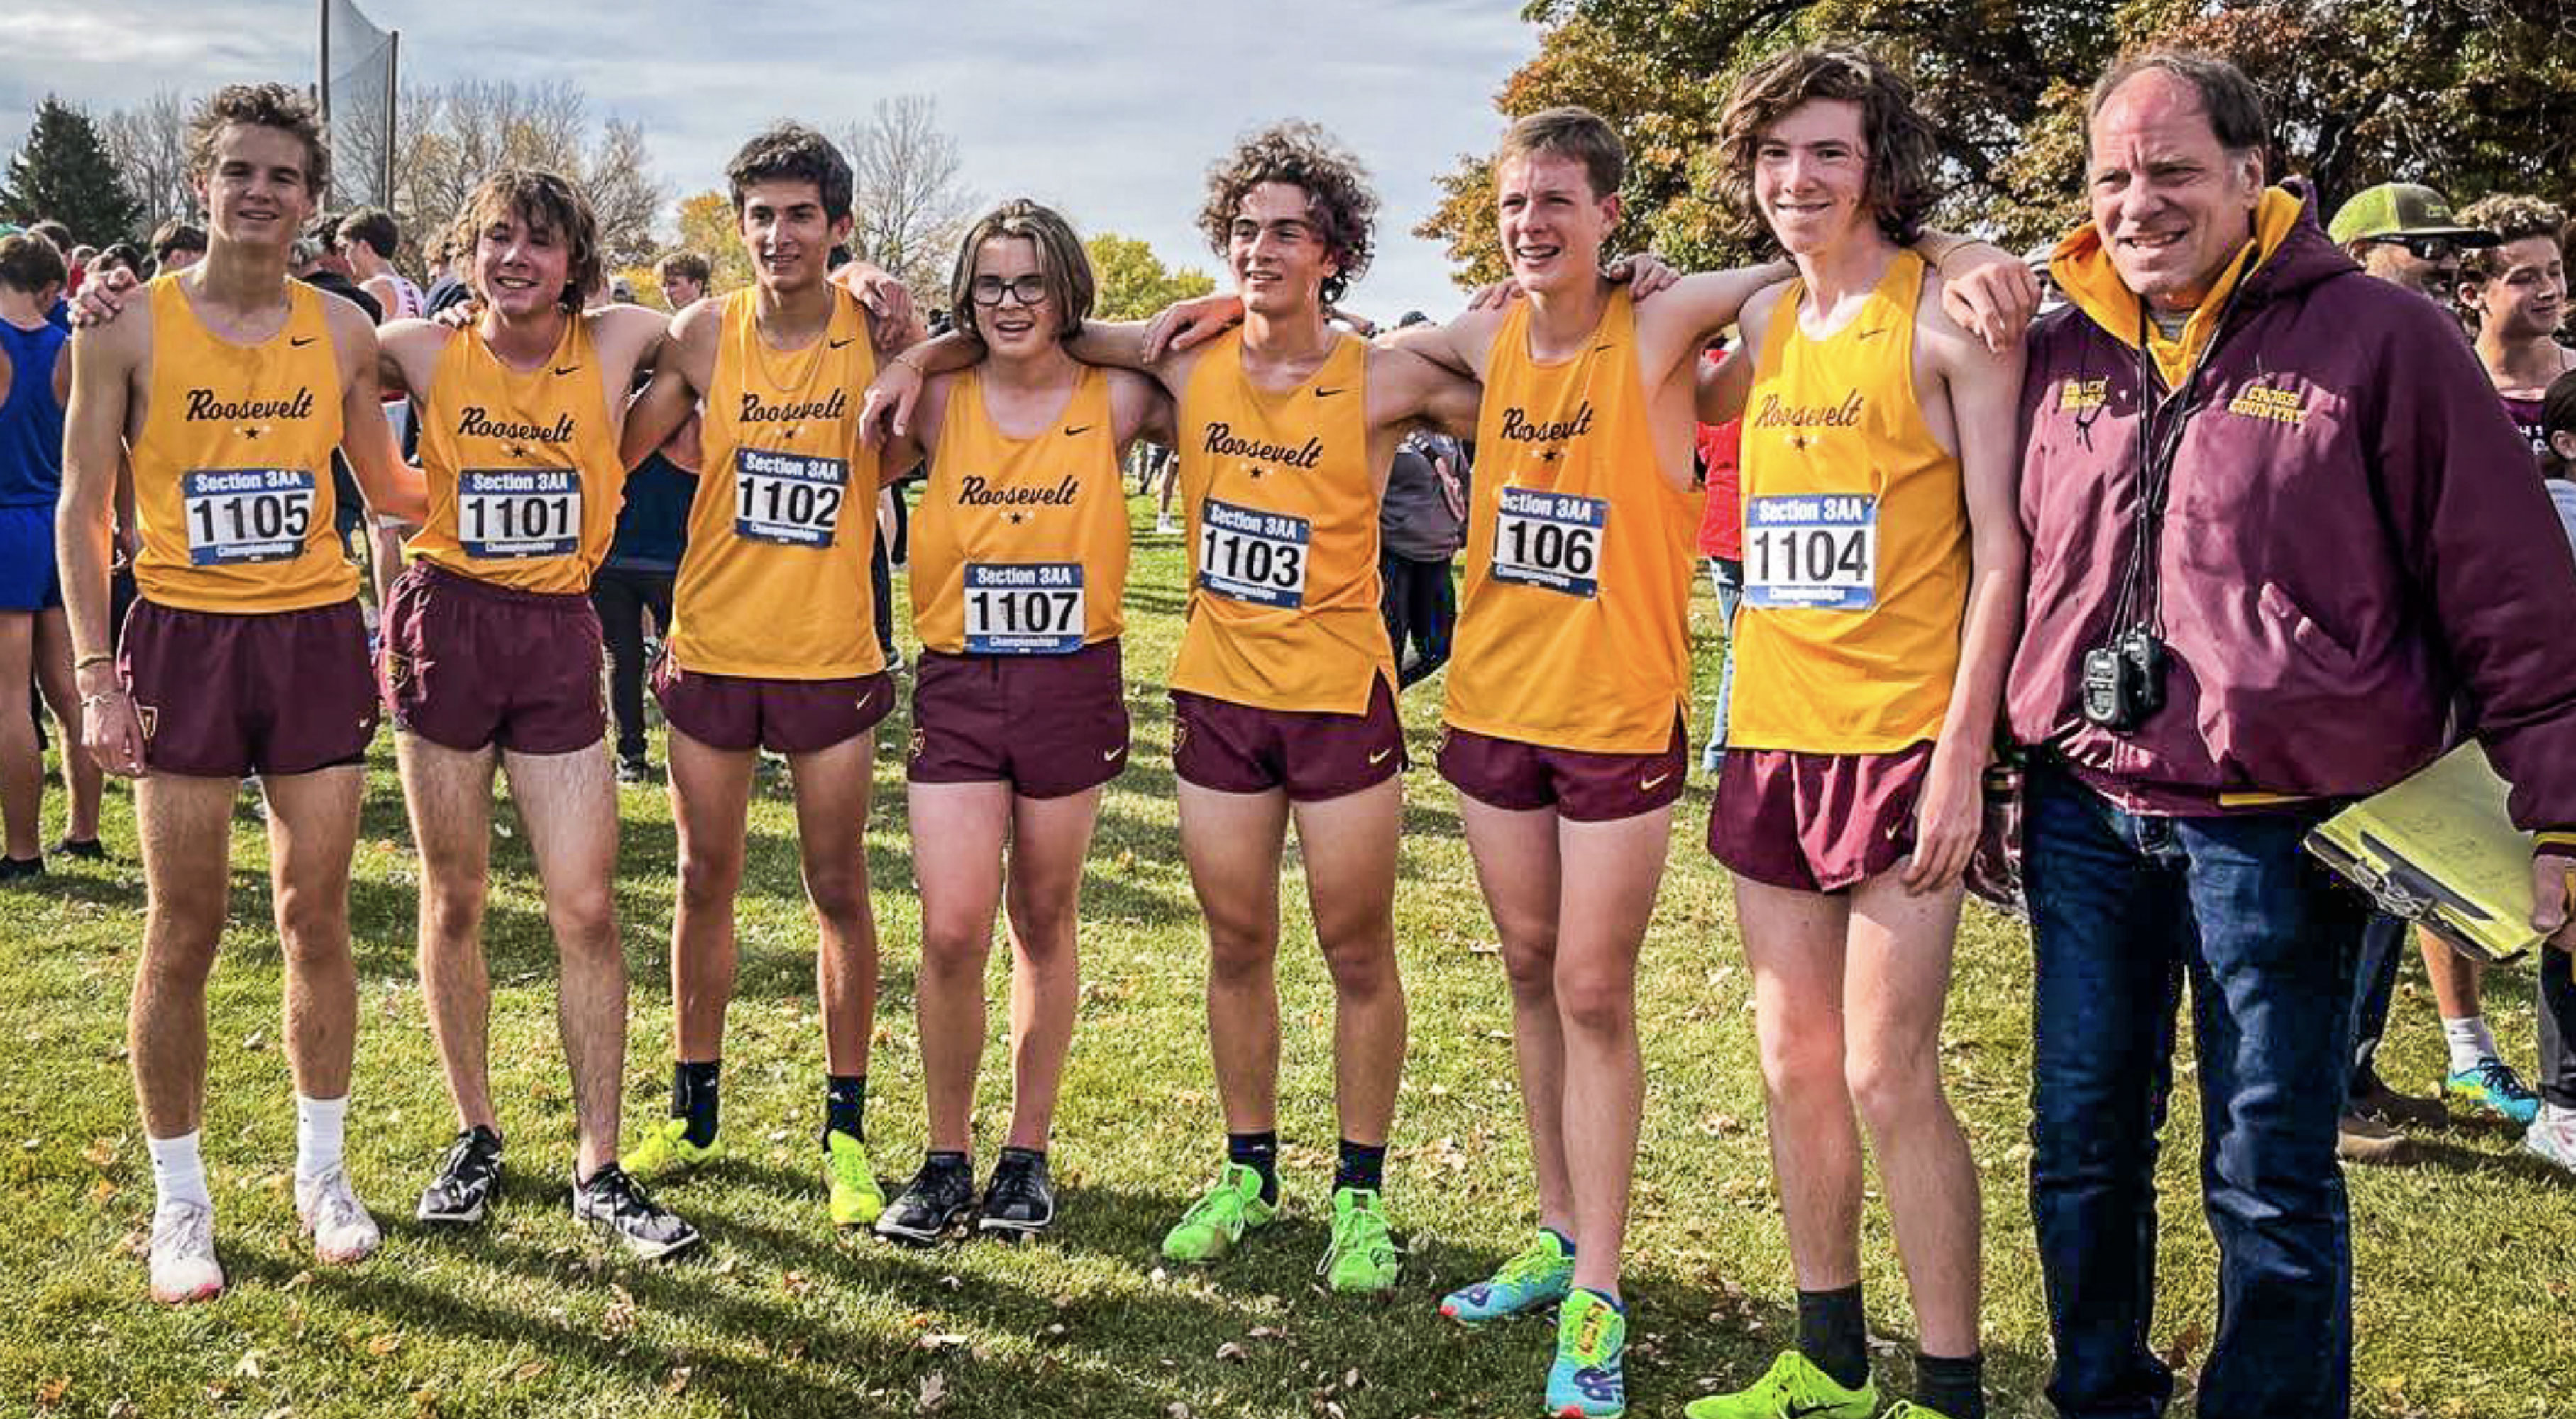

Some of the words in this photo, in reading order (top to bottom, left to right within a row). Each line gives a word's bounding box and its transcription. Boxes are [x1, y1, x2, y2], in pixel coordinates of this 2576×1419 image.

[187, 387, 313, 421] Roosevelt
[740, 388, 846, 421] Roosevelt
[458, 407, 573, 443] Roosevelt
[1501, 401, 1593, 443] Rosevlt
[1205, 423, 1323, 469] Roosevelt
[195, 473, 262, 492] Section
[265, 471, 302, 487] 3AA
[473, 473, 533, 492] Section
[538, 472, 568, 491] 3AA
[746, 453, 804, 477] Section
[808, 460, 838, 480] 3AA
[740, 477, 840, 527] 1102
[959, 475, 1079, 504] Roosevelt
[1503, 492, 1553, 516] ection
[1556, 499, 1592, 521] 3AA
[193, 494, 309, 542] 1105
[467, 497, 568, 538] 1101
[1211, 504, 1262, 532] Section
[1265, 517, 1297, 539] 3AA
[1758, 501, 1819, 521] Section
[1823, 498, 1863, 521] 3AA
[1205, 529, 1300, 587] 1103
[1754, 530, 1868, 581] 1104
[977, 568, 1035, 585] Section
[1038, 568, 1072, 585] 3AA
[971, 592, 1079, 632] 1107
